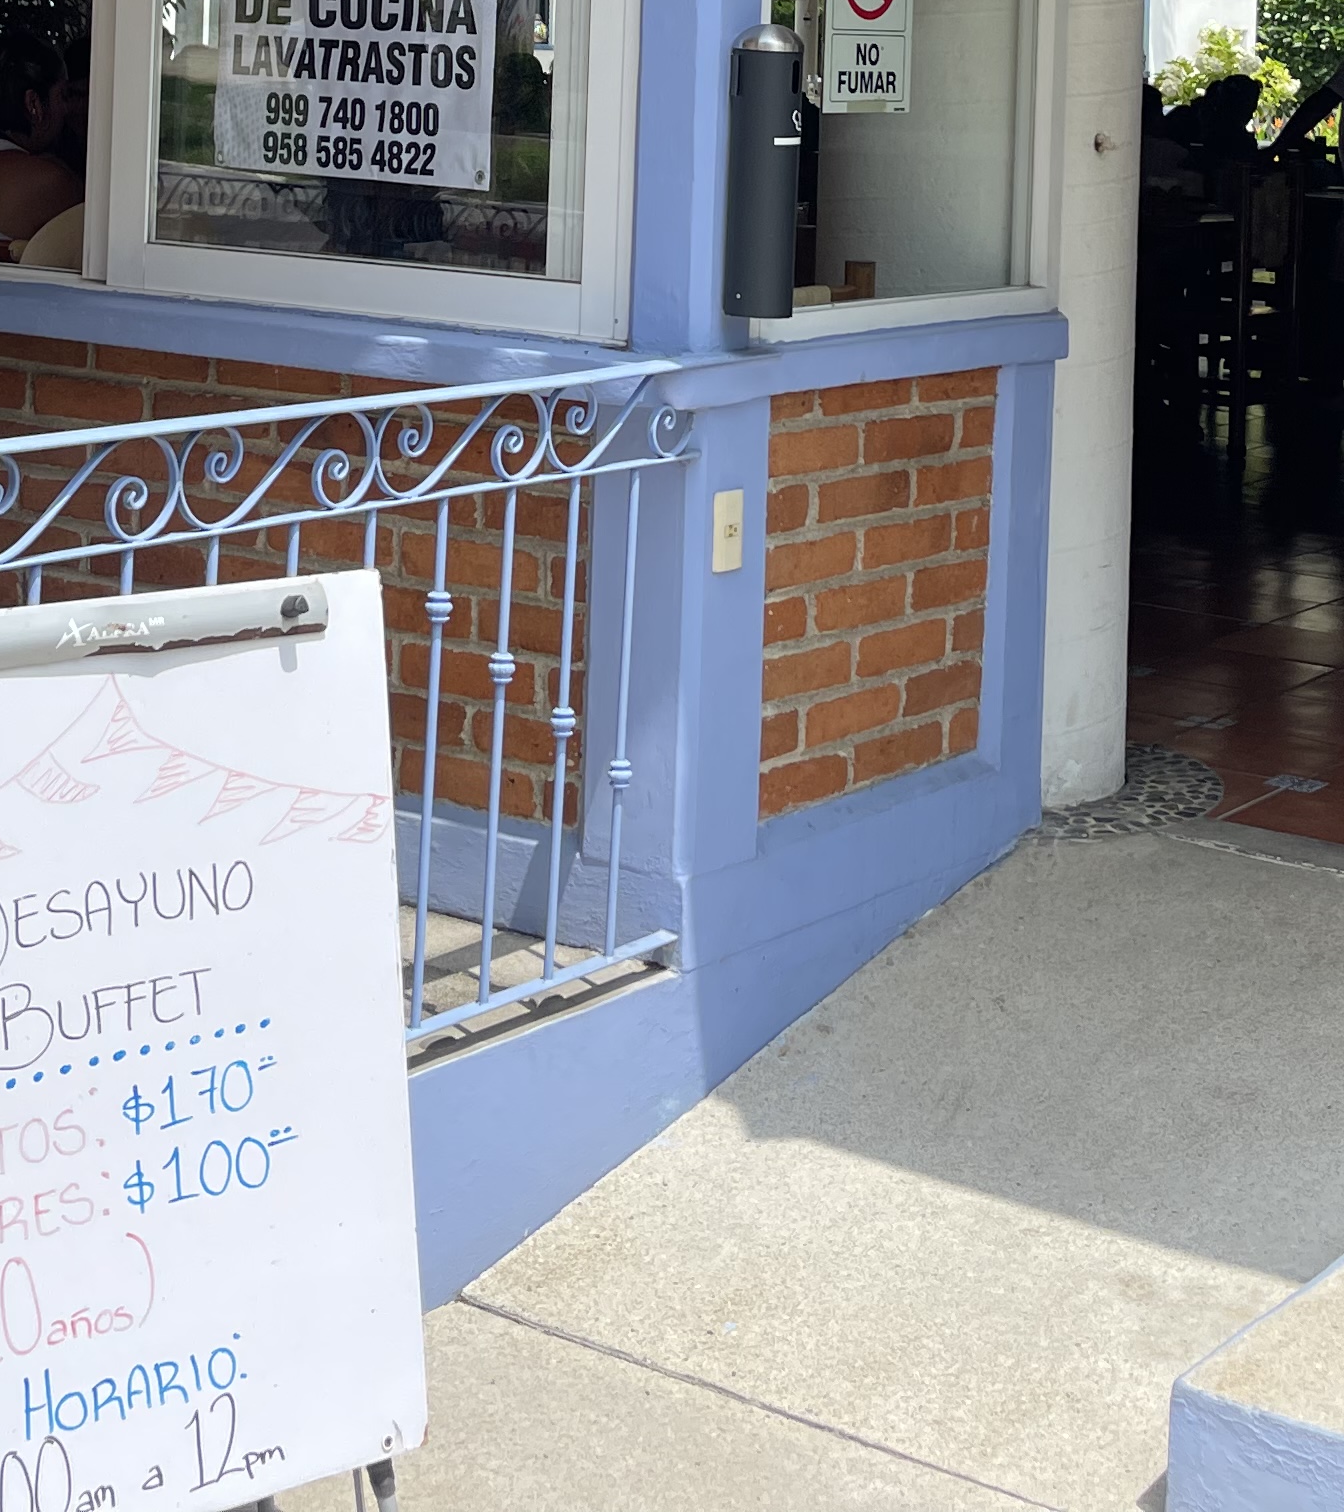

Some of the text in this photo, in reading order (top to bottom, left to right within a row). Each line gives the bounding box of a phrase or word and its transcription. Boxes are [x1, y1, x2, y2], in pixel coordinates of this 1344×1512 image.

[231, 35, 476, 90] LAVATRASTOS
[856, 43, 880, 66] NO
[837, 71, 897, 94] FUMAR
[265, 91, 440, 136] 999 740 1800
[262, 130, 436, 177] 958 585 4822
[141, 1465, 165, 1490] a
